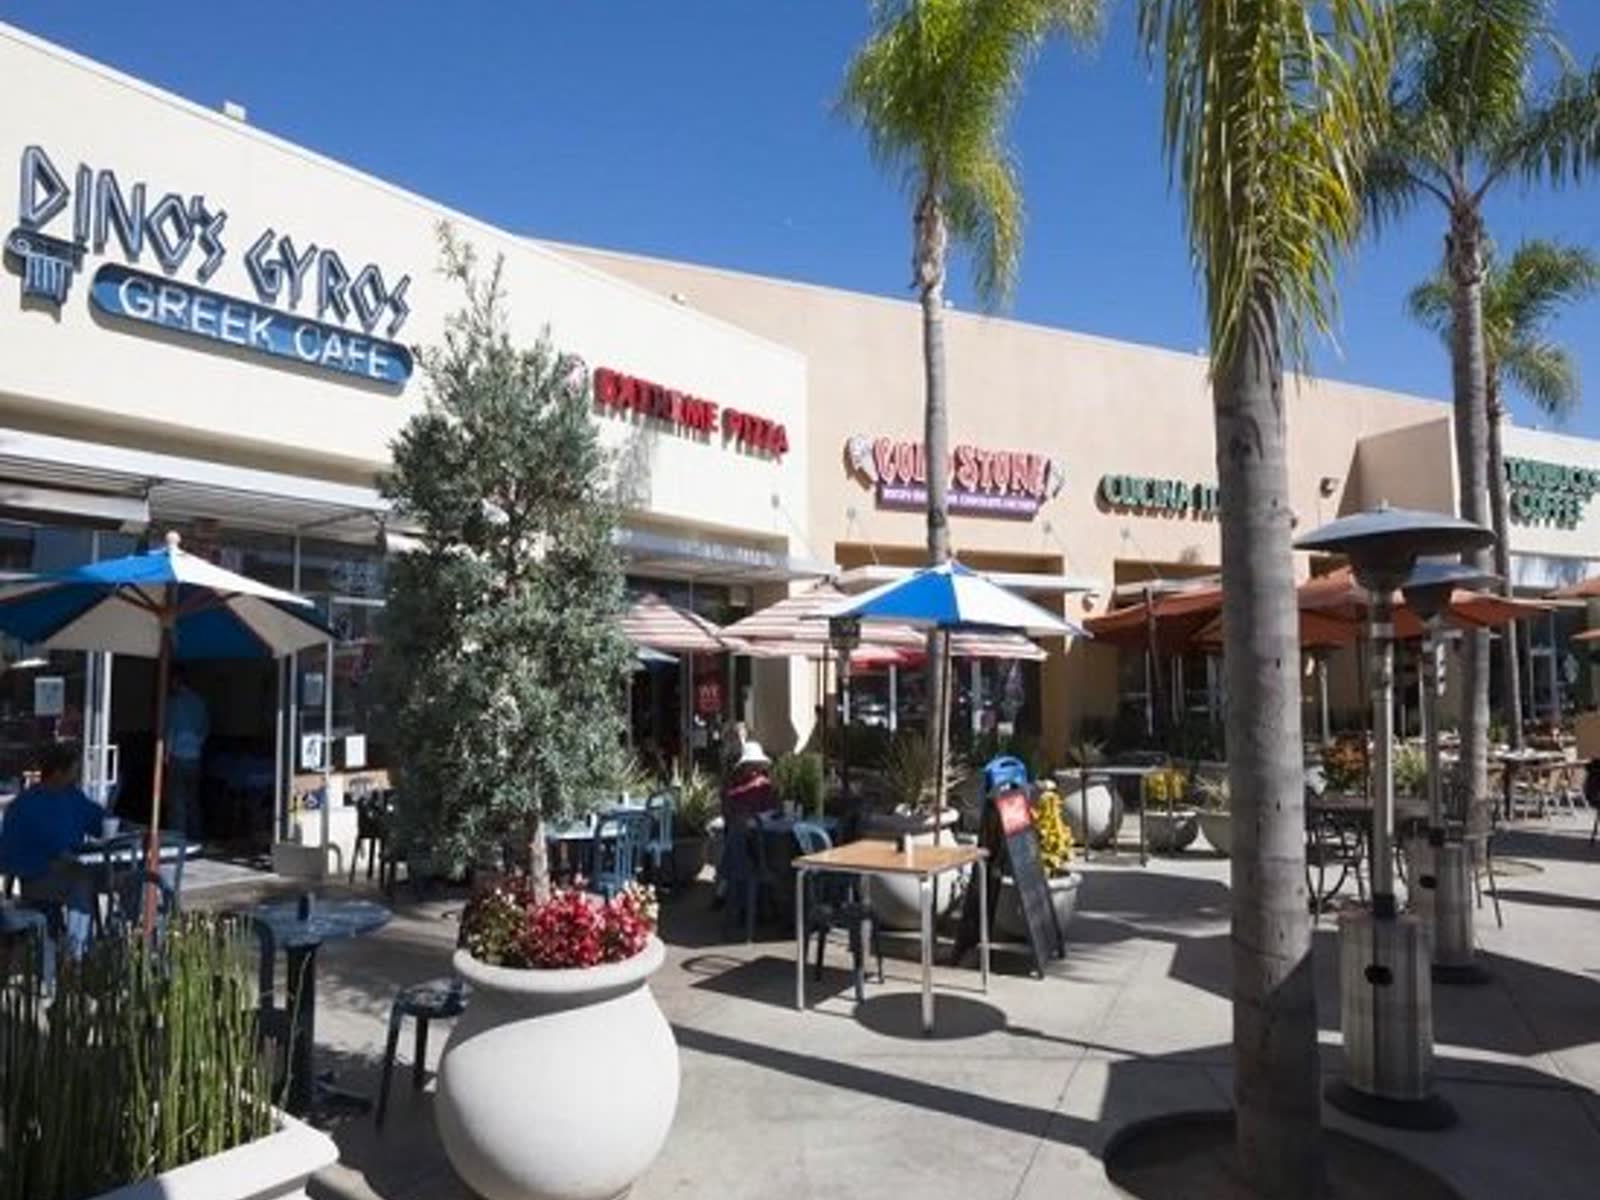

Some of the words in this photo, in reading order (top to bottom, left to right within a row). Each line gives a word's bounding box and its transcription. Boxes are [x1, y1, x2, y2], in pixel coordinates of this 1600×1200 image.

[19, 145, 228, 284] DINO'S
[244, 228, 412, 338] GYROS
[118, 276, 276, 354] GREEK
[294, 325, 391, 380] CAFE
[593, 367, 719, 434] EXTREME
[721, 407, 789, 453] PIZZA
[872, 436, 953, 484] COL
[1099, 474, 1192, 511] CUCINA
[1514, 487, 1585, 522] COFFEE
